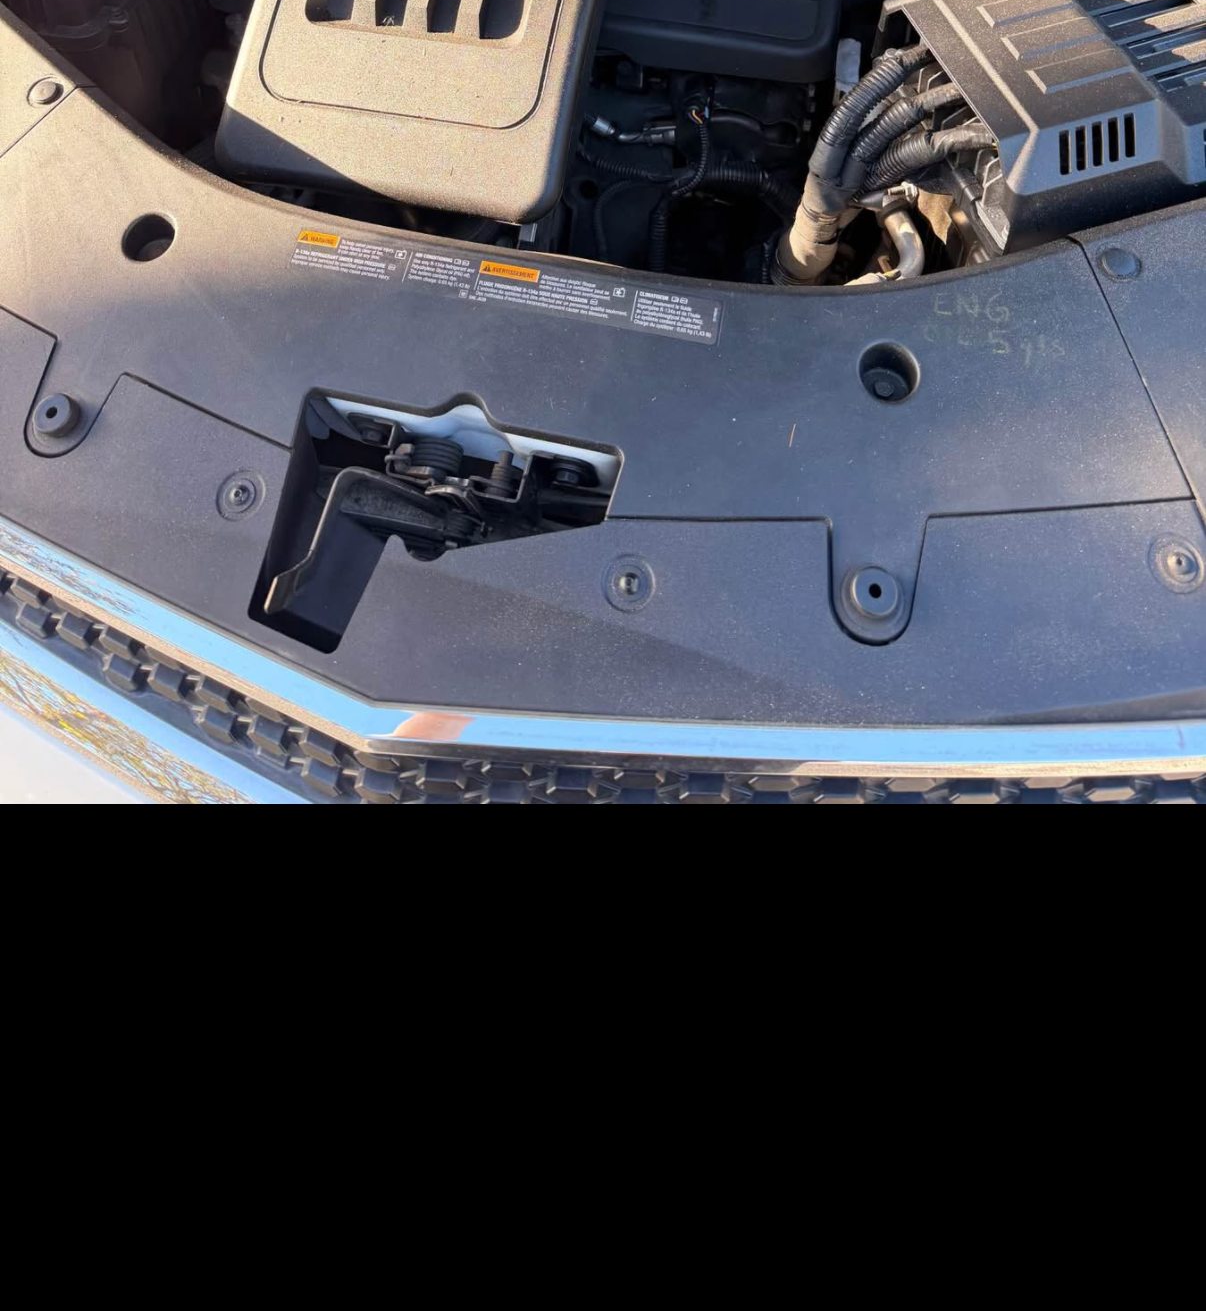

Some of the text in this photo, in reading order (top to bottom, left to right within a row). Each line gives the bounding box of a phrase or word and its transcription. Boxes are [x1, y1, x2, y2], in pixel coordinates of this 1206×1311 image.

[311, 236, 334, 245] WARNING
[423, 254, 453, 263] CONDITIONING
[492, 267, 534, 278] AVERTISSEMENT
[566, 296, 588, 304] PRESSION
[640, 291, 669, 301] CLIMATISEUR
